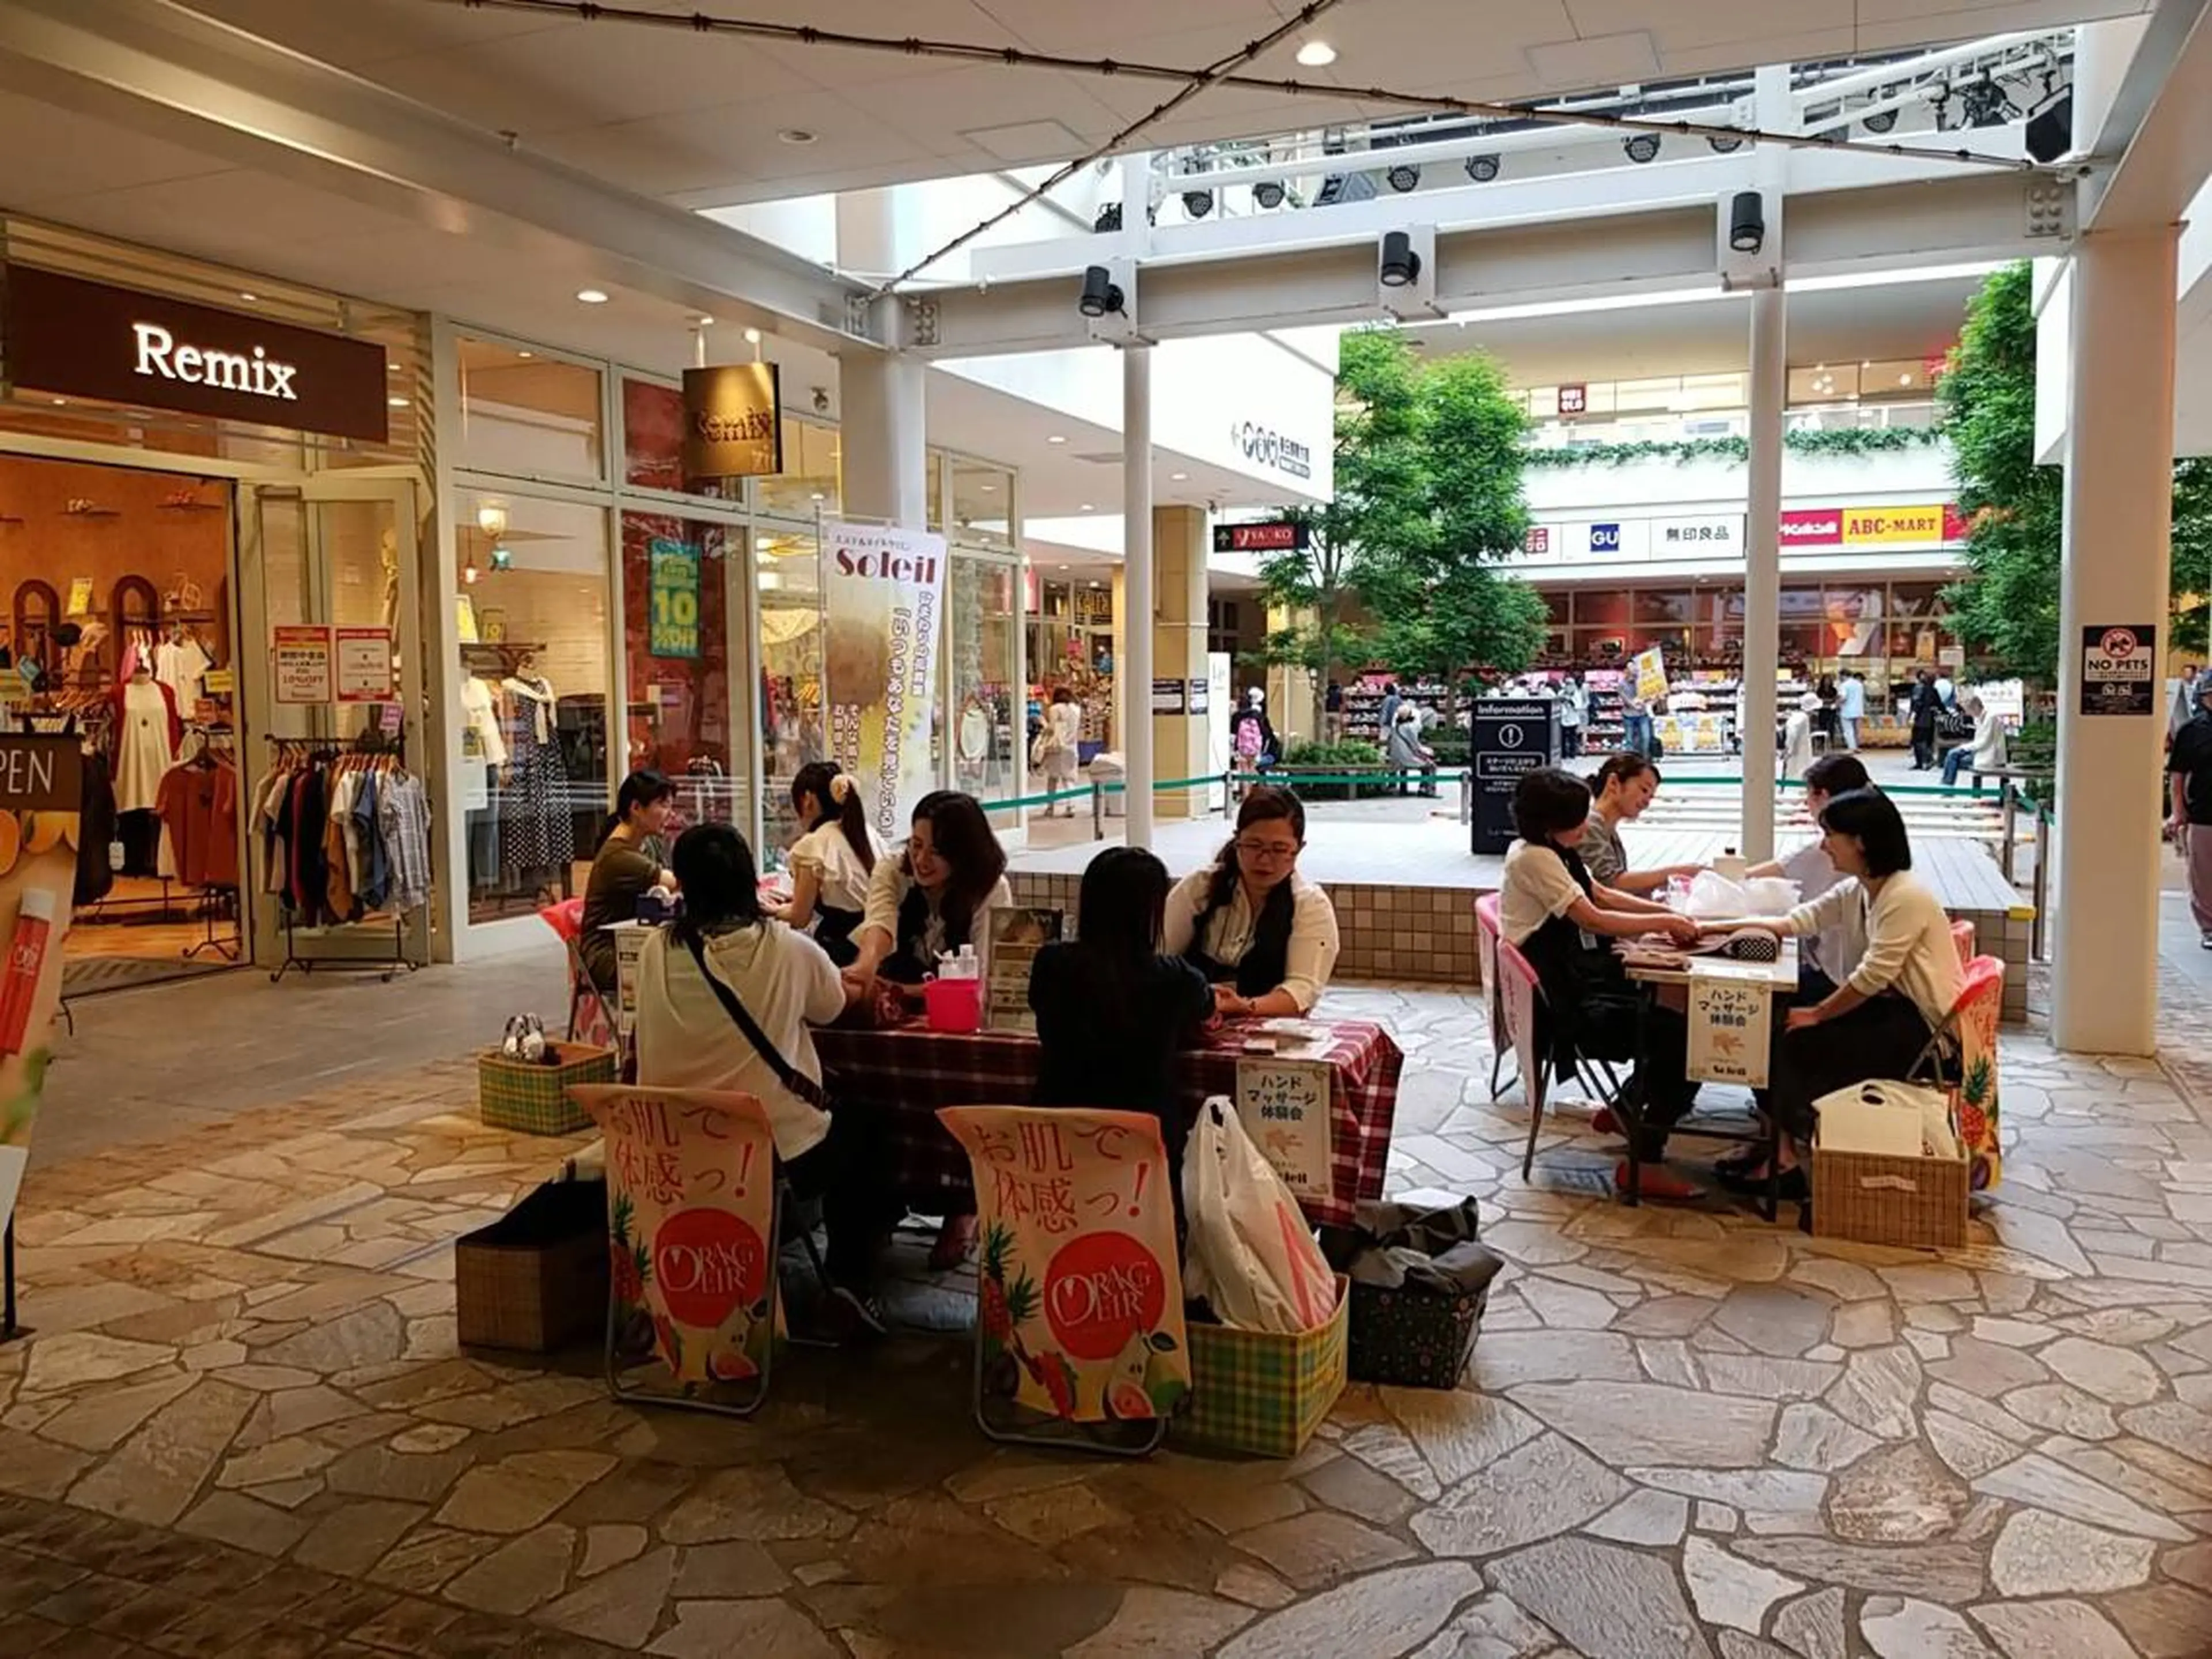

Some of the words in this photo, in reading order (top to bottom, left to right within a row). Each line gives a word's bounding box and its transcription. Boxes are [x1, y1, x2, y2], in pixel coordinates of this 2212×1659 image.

[132, 324, 297, 400] Remix
[1666, 526, 1729, 541] 無印良品
[1849, 518, 1936, 535] ABC-MART
[1591, 531, 1619, 546] GU
[835, 548, 935, 584] Soleil
[654, 588, 696, 624] 10
[2088, 660, 2112, 670] NO
[2116, 659, 2148, 670] PETS
[1478, 703, 1544, 714] Information
[1711, 989, 1747, 1003] ハンド
[1698, 1001, 1759, 1015] マッサージ
[1261, 1075, 1302, 1090] ハンド
[1247, 1089, 1317, 1105] マッサージ
[975, 1122, 1129, 1172] お肌で
[615, 1139, 752, 1205] 体感っ!
[995, 1162, 1148, 1233] 体感っ!
